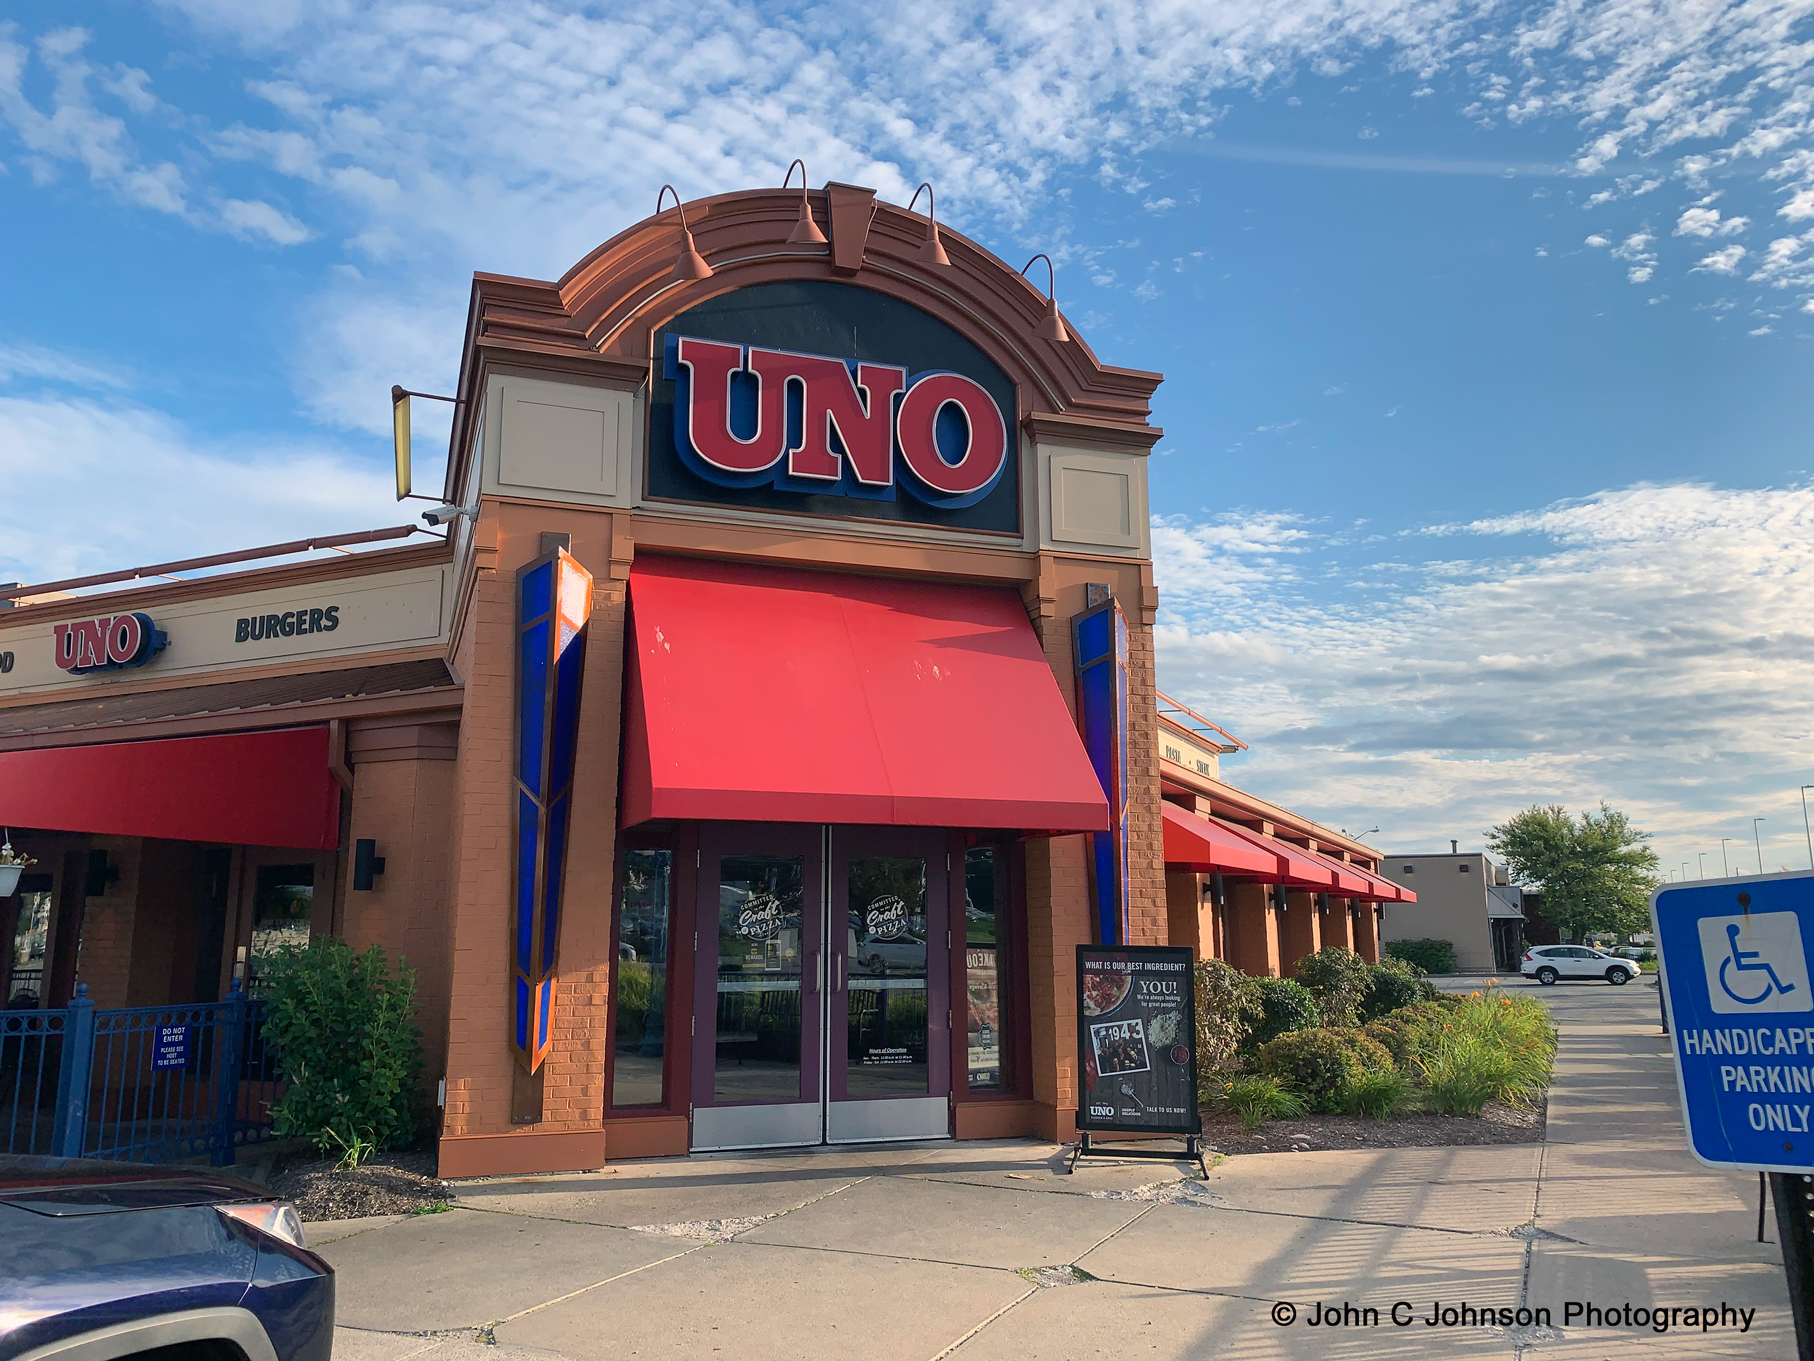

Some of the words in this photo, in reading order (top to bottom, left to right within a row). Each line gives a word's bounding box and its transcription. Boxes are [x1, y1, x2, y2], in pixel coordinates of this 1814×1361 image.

[677, 335, 1008, 495] UNO
[235, 605, 340, 643] BURGERS
[53, 613, 142, 670] UNO
[1165, 745, 1181, 764] PASTA
[741, 894, 773, 910] COMMITTED
[867, 896, 898, 911] COMMITTED
[739, 899, 781, 926] Craft
[867, 900, 905, 926] Craft
[749, 918, 782, 936] PIZZA
[876, 918, 907, 935] PIZZA
[1085, 961, 1103, 970] WHAT
[1104, 961, 1111, 970] IS
[1112, 962, 1126, 970] OUR
[1127, 962, 1143, 970] BEST
[1144, 963, 1186, 971] INGREDIENT?
[1139, 980, 1177, 994] YOU!
[1108, 1022, 1143, 1041] 1943
[1720, 1066, 1814, 1093] PARKIN
[1089, 1106, 1115, 1116] UNO
[1749, 1103, 1811, 1133] ONLY
